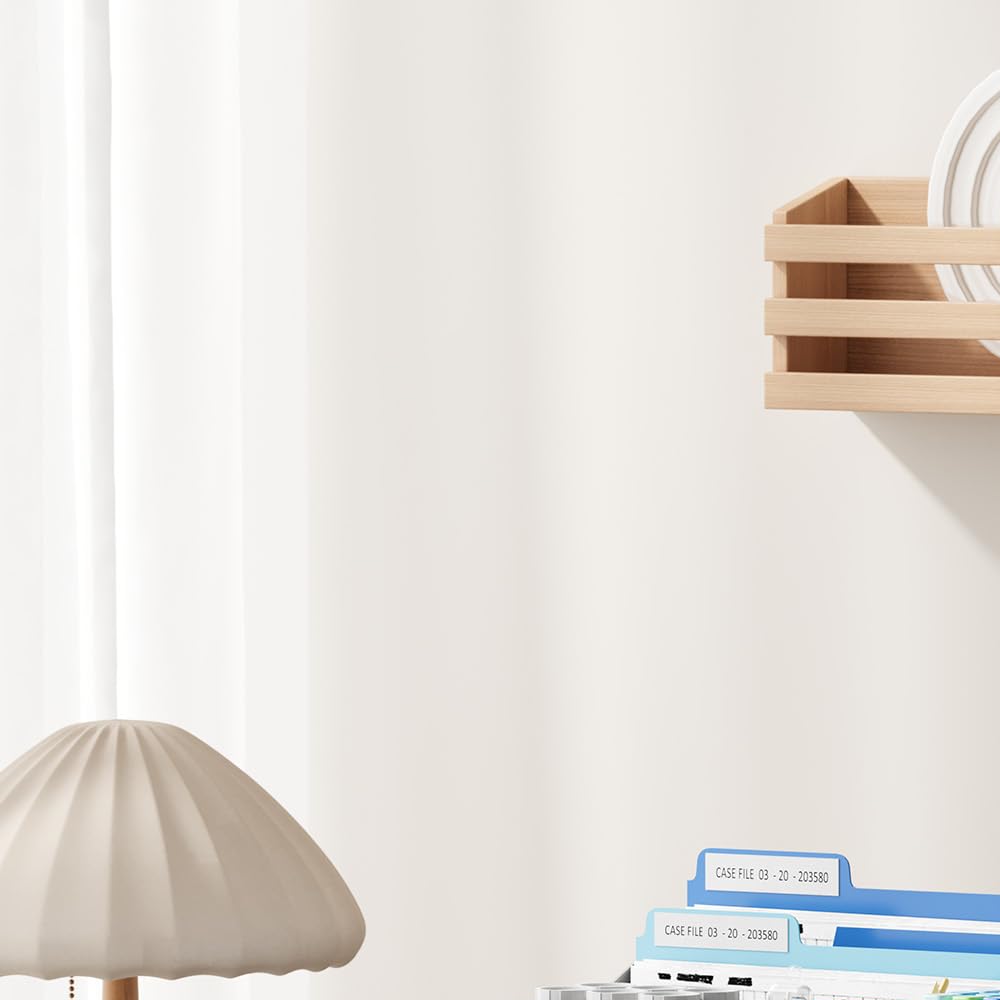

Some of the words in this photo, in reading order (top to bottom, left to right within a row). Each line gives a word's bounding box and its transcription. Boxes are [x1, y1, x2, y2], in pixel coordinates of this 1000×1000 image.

[715, 866, 736, 879] CASE
[738, 867, 754, 880] FILE
[758, 869, 769, 880] 03
[778, 870, 789, 881] 20
[798, 870, 829, 883] 203580
[664, 925, 685, 936] CASE
[687, 925, 703, 937] FILE
[707, 927, 718, 938] 03
[727, 928, 738, 938] 20
[747, 929, 778, 941] 203580
